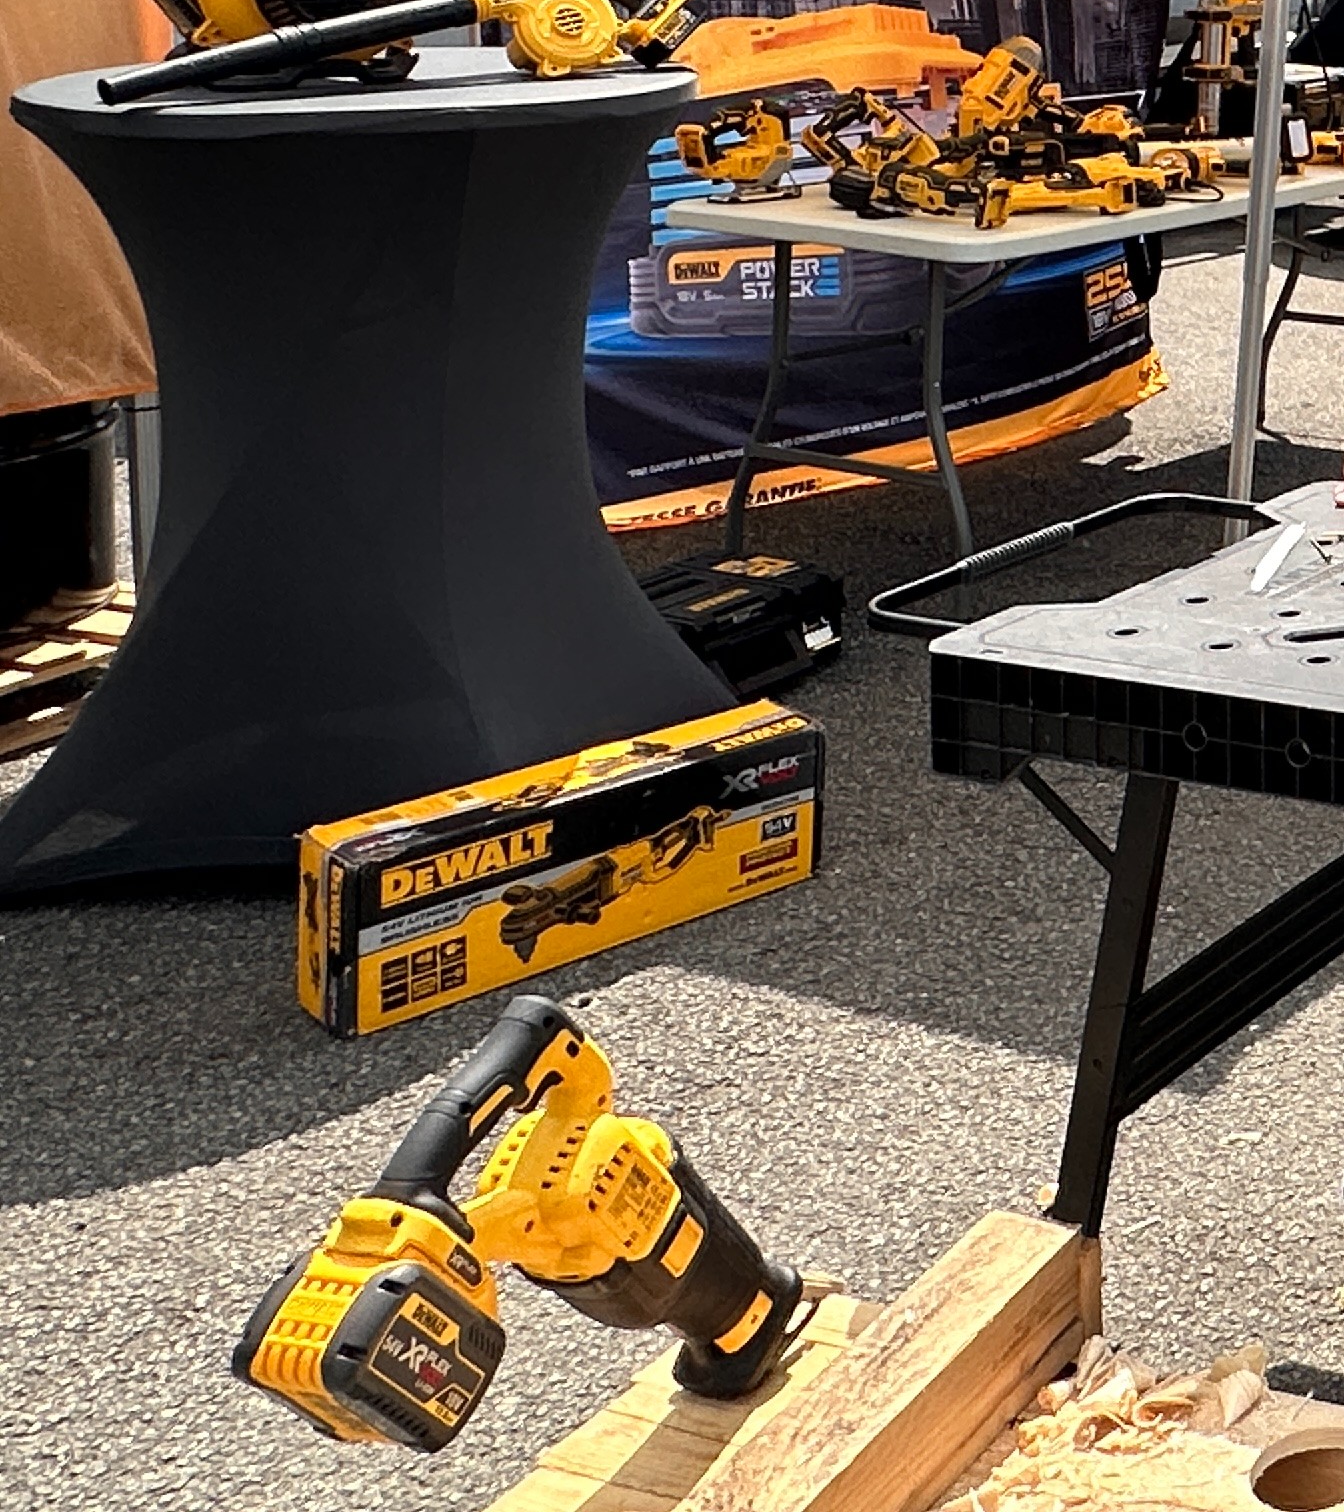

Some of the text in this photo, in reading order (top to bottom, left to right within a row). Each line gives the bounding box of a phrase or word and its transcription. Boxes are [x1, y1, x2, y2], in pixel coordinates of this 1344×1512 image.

[675, 257, 820, 280] DEWALT POER
[1087, 263, 1131, 308] 25
[742, 279, 815, 300] STCK
[704, 479, 816, 516] GRANTIE
[381, 823, 553, 907] DEWALT
